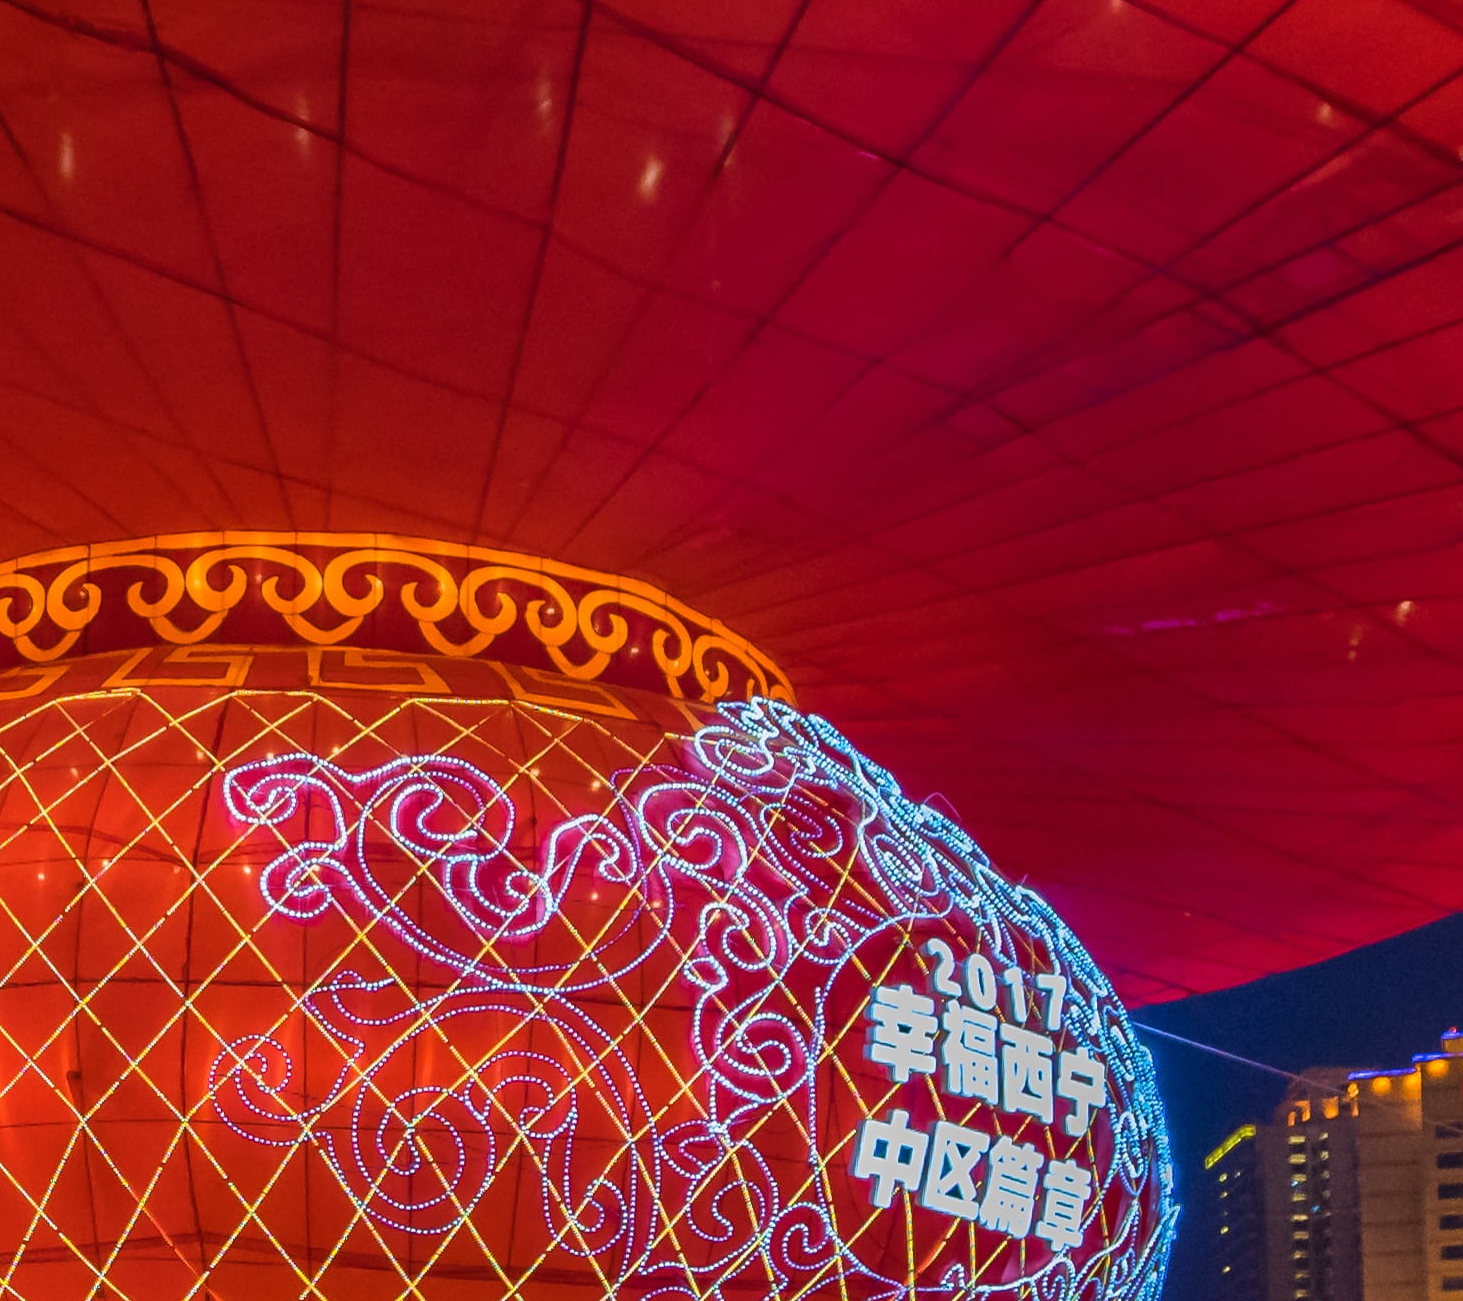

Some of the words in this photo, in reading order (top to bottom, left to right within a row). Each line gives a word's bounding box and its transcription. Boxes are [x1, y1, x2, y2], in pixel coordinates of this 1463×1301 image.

[925, 938, 1067, 1032] 2017
[867, 984, 1109, 1138] 幸福西宁
[853, 1110, 1093, 1252] 中区篇章
